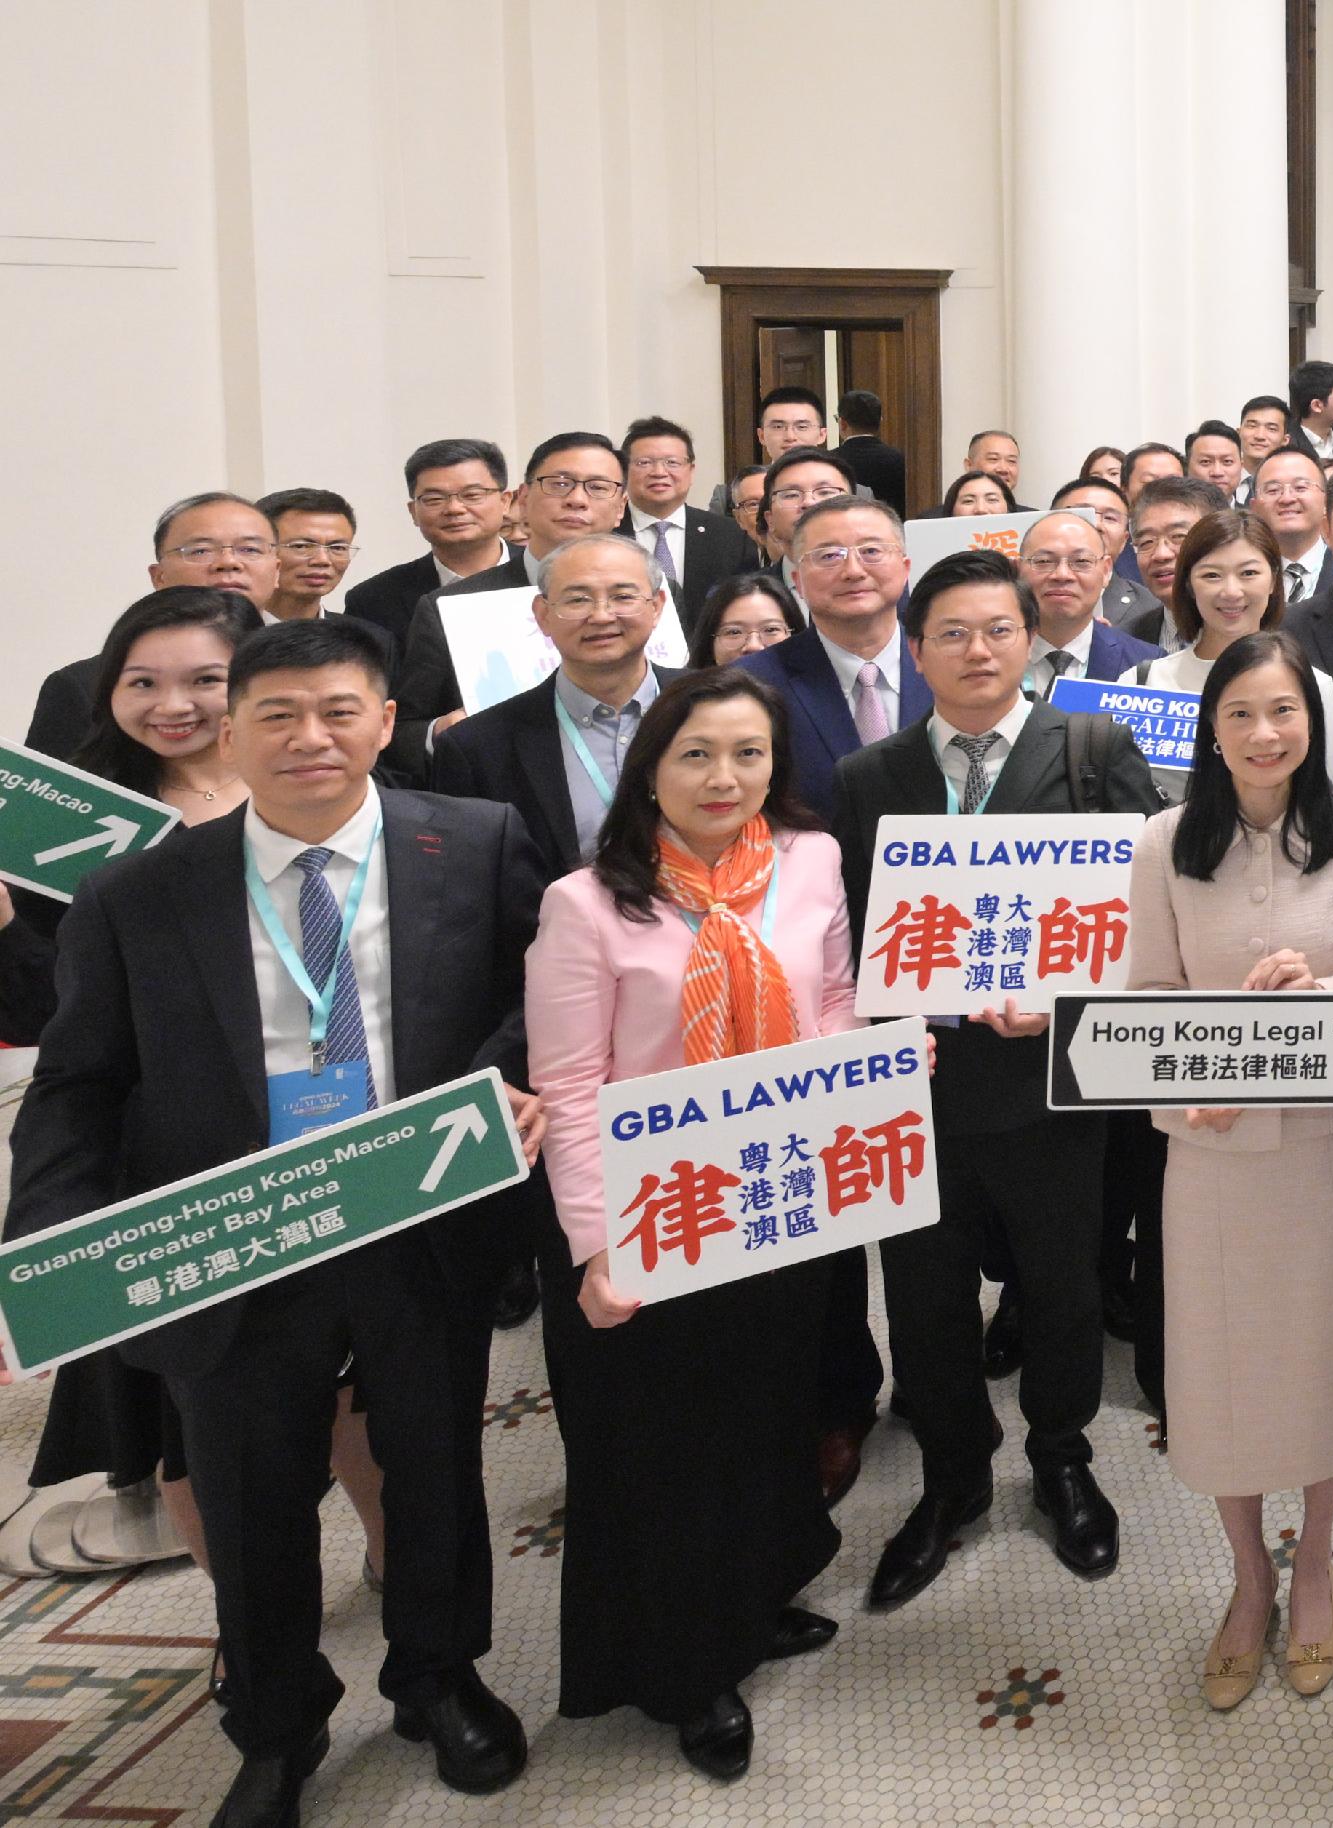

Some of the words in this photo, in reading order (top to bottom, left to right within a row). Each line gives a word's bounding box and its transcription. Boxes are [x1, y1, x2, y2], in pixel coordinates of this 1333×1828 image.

[1100, 692, 1165, 714] HONG
[1167, 699, 1201, 718] KO
[883, 841, 957, 866] GBA
[969, 839, 1134, 866] LAWYERS
[1092, 1021, 1164, 1047] Hong
[1174, 1021, 1243, 1046] Kong
[1252, 1020, 1324, 1045] Legal
[611, 1098, 708, 1142] GBA
[722, 1047, 919, 1117] LAWYERS
[1151, 1053, 1328, 1082] 香港法律樞紐
[8, 1182, 255, 1284] Guangdong-Hong
[260, 1123, 416, 1189] Kong-Macao
[114, 1223, 218, 1274] Greater
[224, 1202, 273, 1233] Bay
[281, 1180, 341, 1212] Area
[126, 1205, 347, 1307] 粵港澳大灣區
